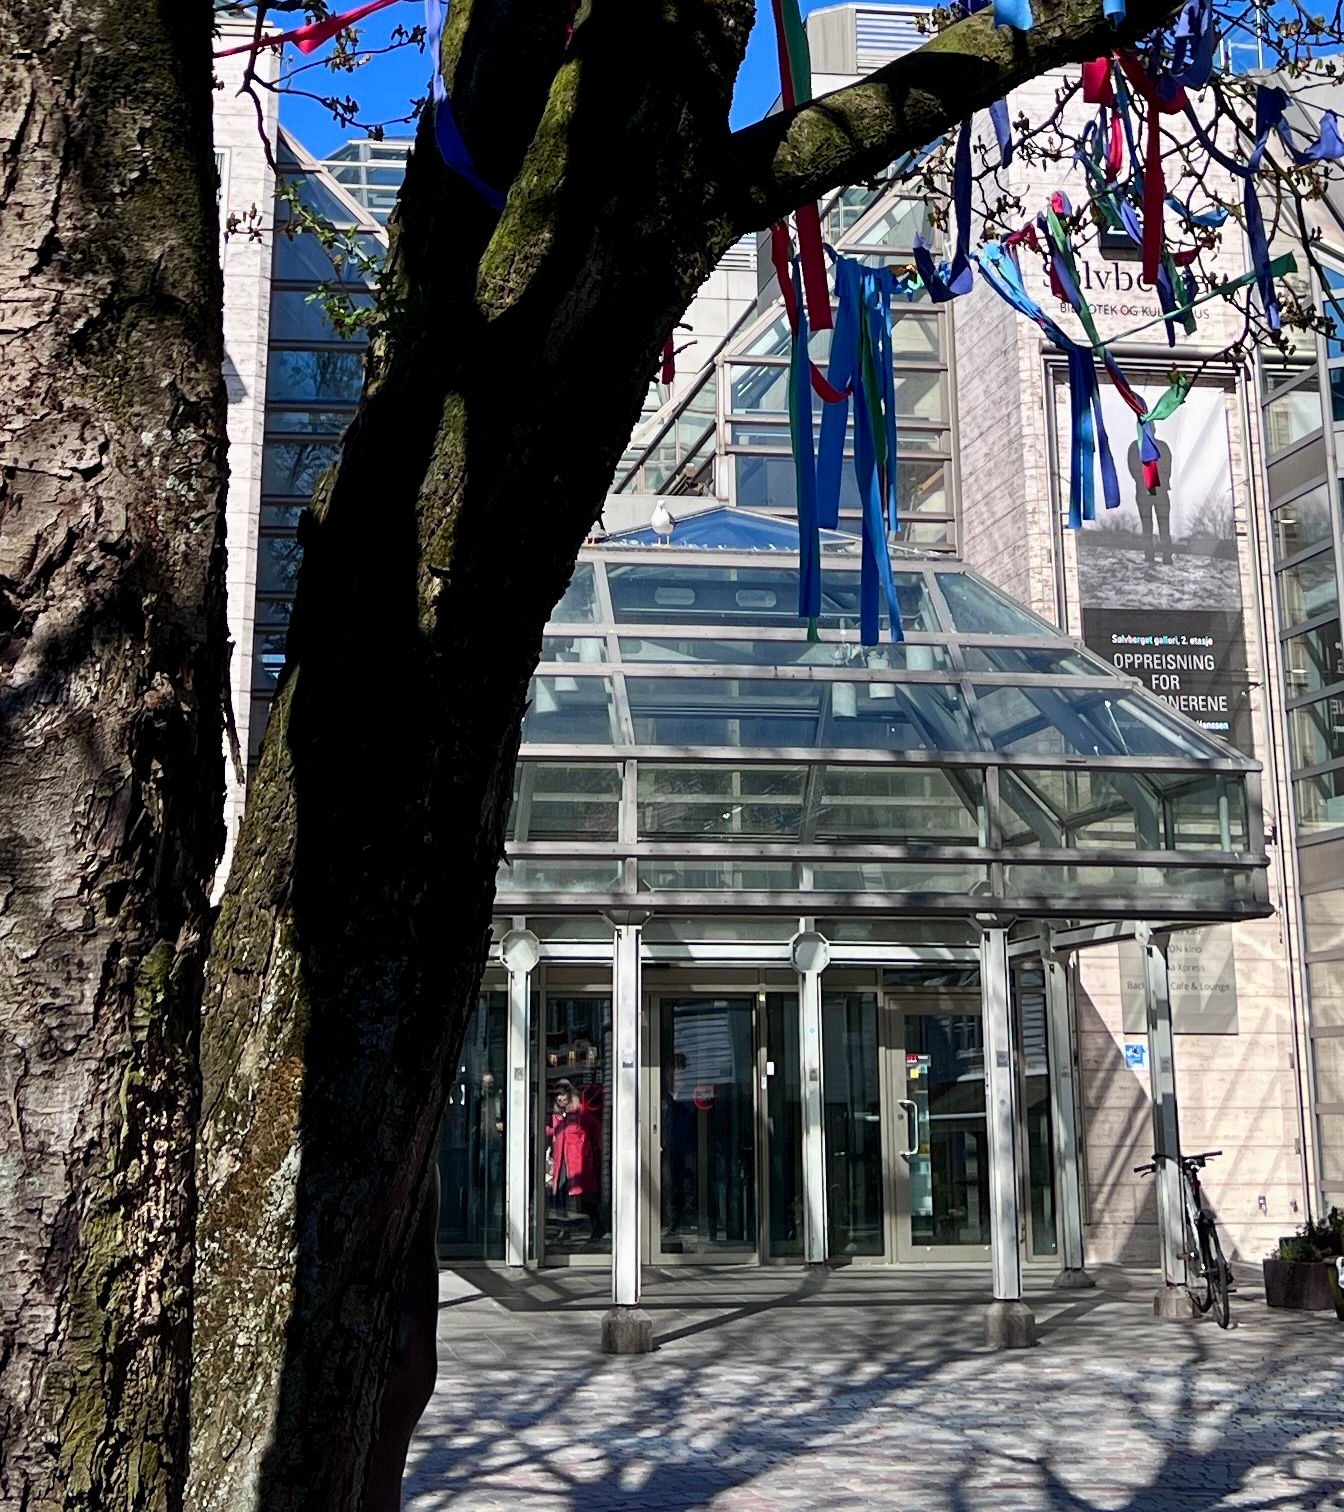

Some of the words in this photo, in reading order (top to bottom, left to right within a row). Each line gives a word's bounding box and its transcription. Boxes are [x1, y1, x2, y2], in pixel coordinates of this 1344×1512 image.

[1121, 304, 1138, 316] OG
[1189, 636, 1214, 647] etasje
[1114, 653, 1215, 670] OPPREISNING
[1151, 674, 1180, 690] FOR
[1200, 982, 1230, 993] Lounge
